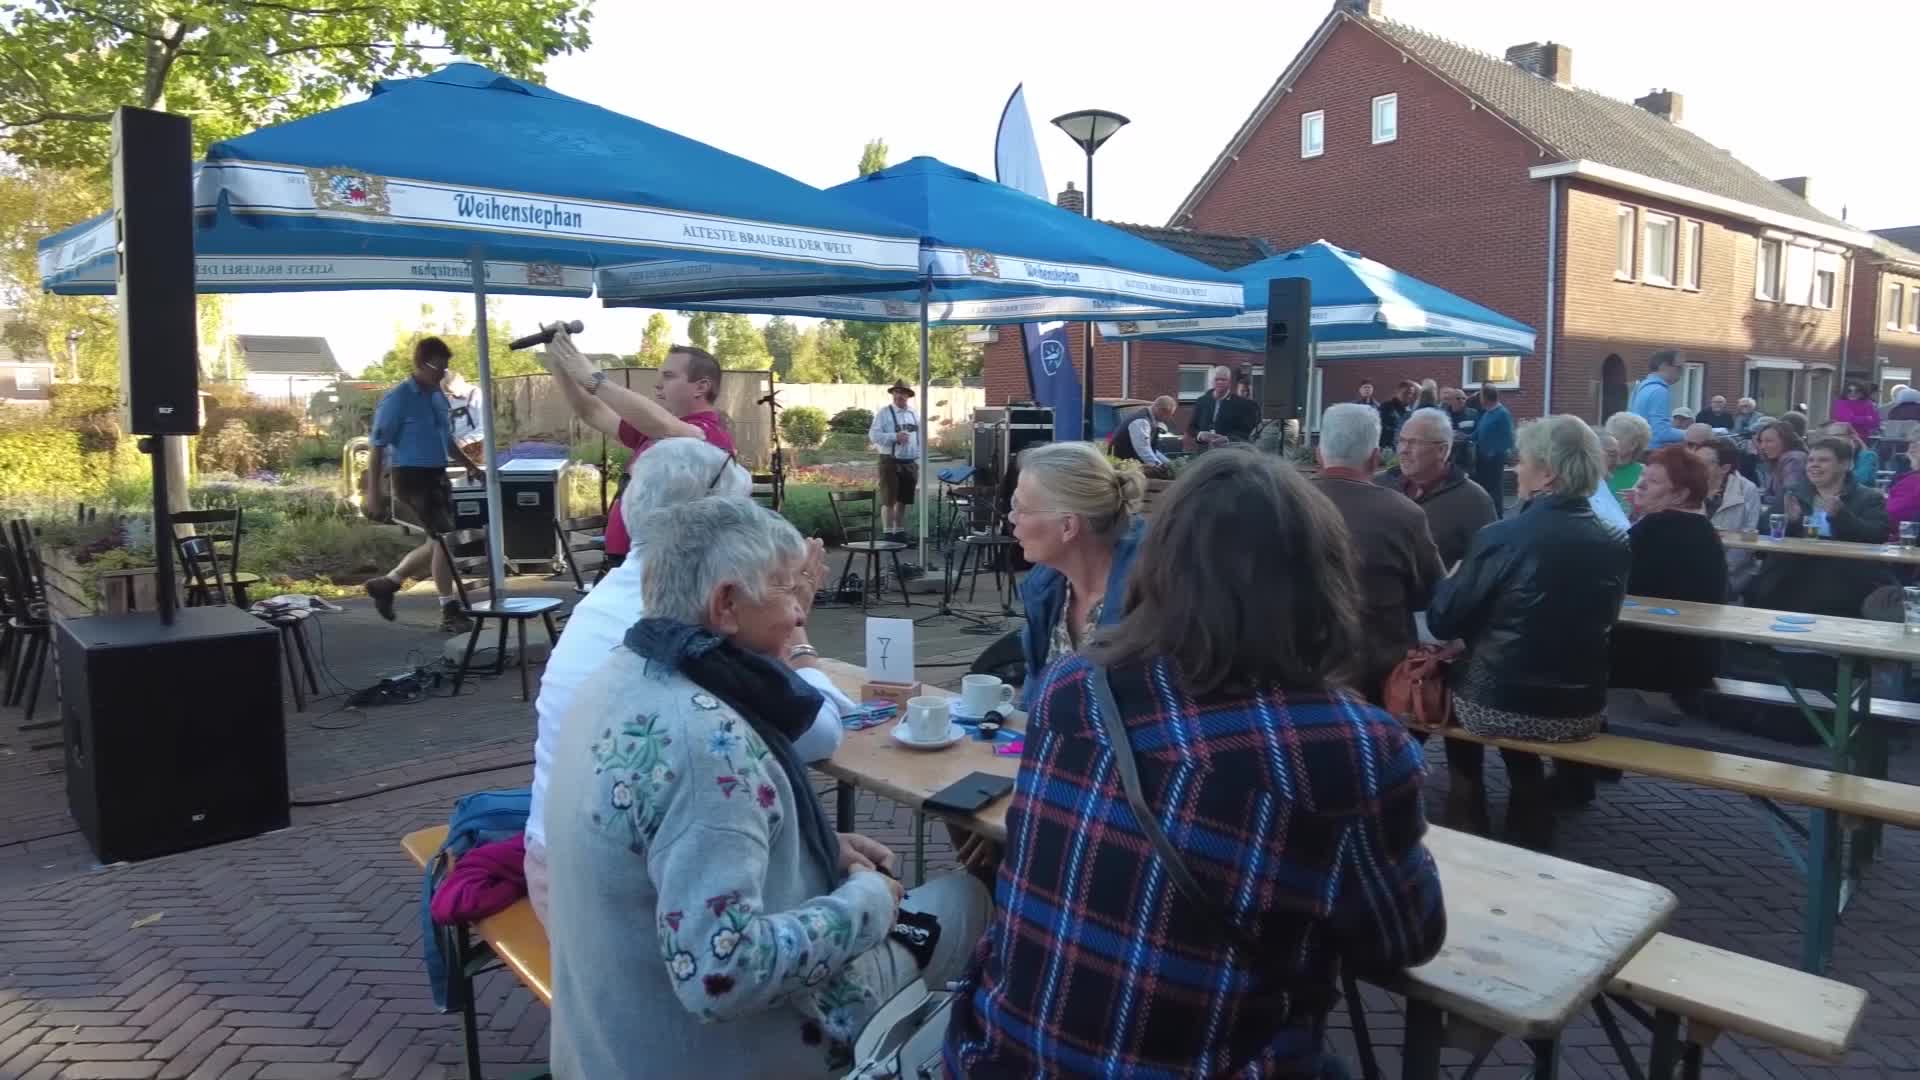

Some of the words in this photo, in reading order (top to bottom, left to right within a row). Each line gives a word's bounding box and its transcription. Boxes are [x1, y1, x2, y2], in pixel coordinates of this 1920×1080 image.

[454, 193, 582, 229] Weihenstephan
[738, 231, 797, 249] BRAUEREI
[799, 239, 822, 250] DER
[823, 241, 854, 255] WELT
[876, 637, 892, 670] 7
